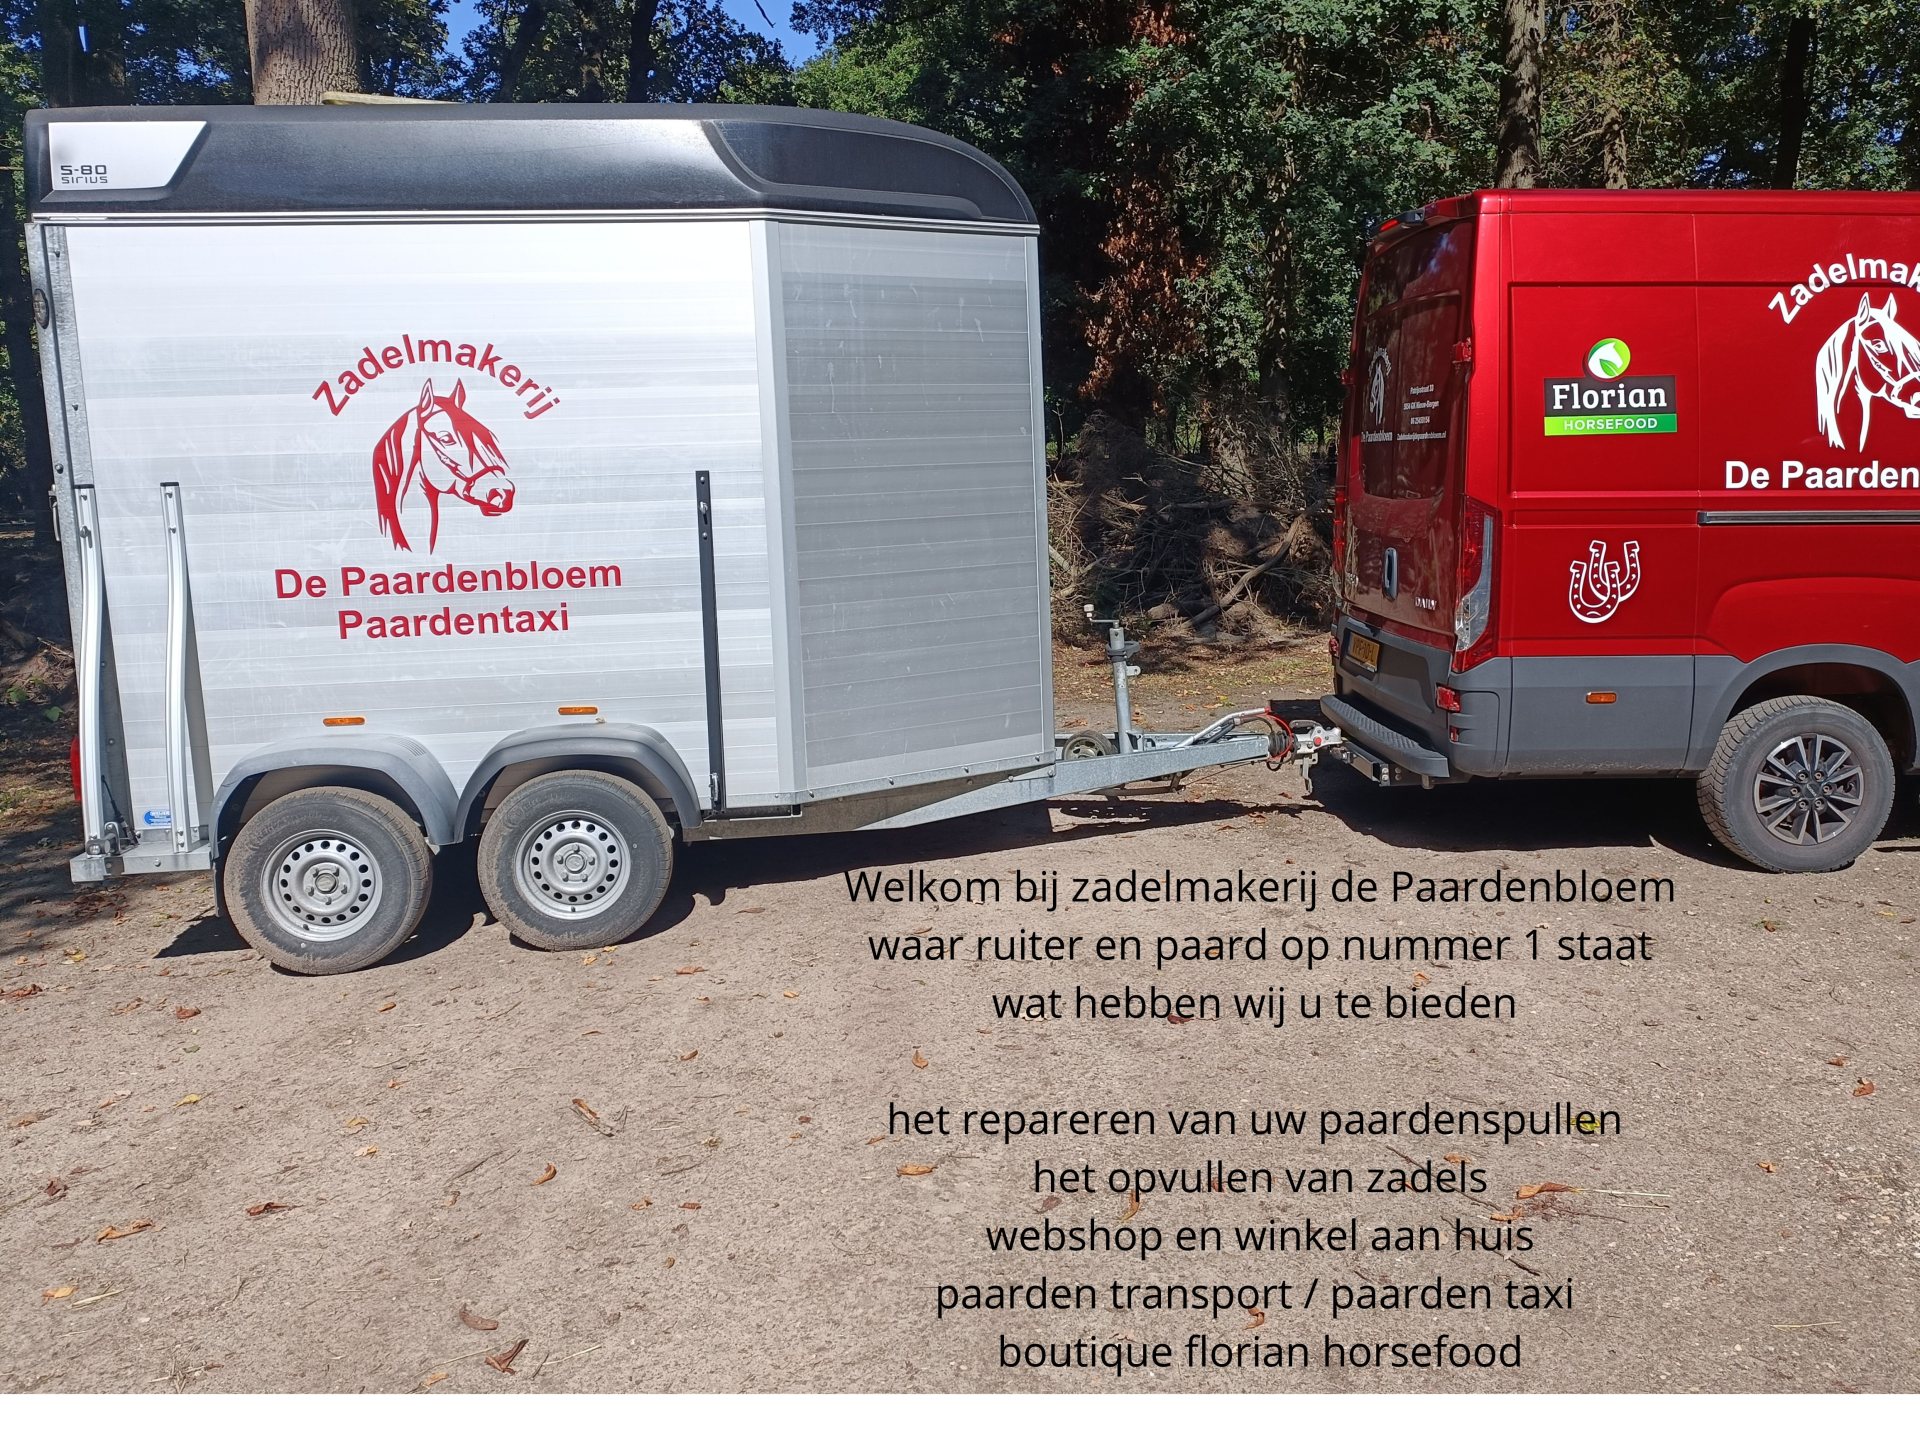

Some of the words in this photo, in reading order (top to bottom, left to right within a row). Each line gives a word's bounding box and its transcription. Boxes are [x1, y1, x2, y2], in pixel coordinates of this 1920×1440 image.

[60, 164, 108, 175] S-80
[312, 333, 560, 420] Zadelmakerij
[1552, 383, 1668, 411] Florian
[1563, 417, 1659, 432] HORSEFOOD
[1724, 460, 1770, 489] De
[1781, 459, 1920, 489] Paarden
[275, 568, 328, 600] De
[341, 560, 623, 597] Paardenbloem
[1415, 596, 1438, 611] DAILY
[338, 601, 570, 640] Paardentaxi
